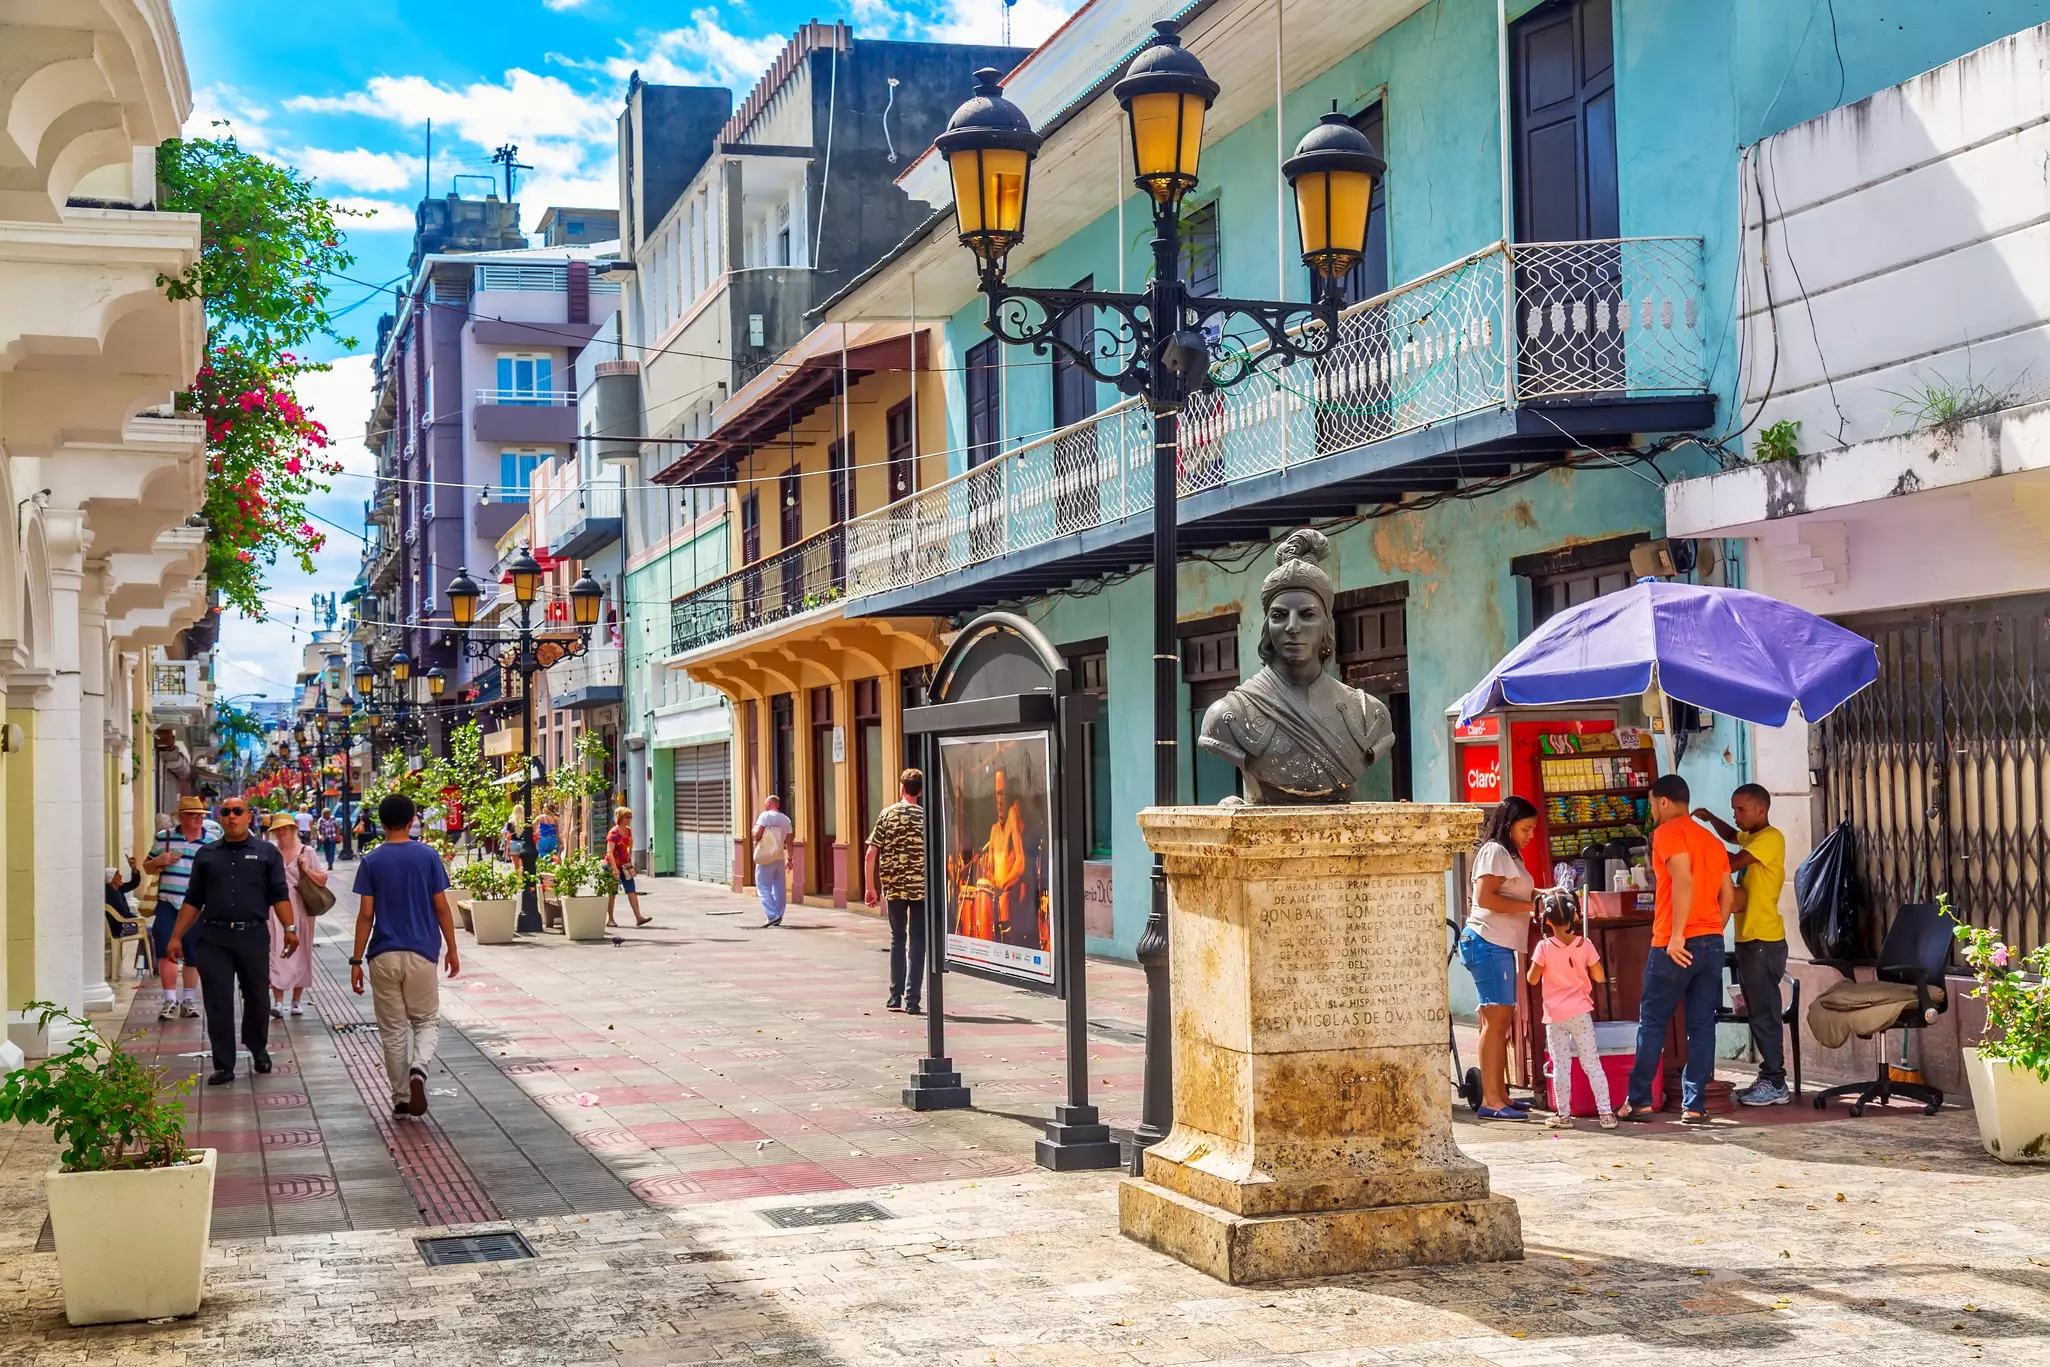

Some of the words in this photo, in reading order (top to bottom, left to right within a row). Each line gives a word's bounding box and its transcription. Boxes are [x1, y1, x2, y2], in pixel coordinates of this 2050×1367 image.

[1467, 725, 1483, 736] Claro
[1467, 769, 1497, 789] Claro
[1327, 881, 1344, 890] DEL
[1347, 880, 1382, 890] PRIMER
[1275, 895, 1286, 905] DE
[1261, 908, 1291, 922] DON
[1330, 923, 1341, 932] LA
[1361, 935, 1373, 944] DE
[1335, 947, 1383, 957] DOMINGO
[1348, 960, 1365, 970] DEL
[1341, 973, 1357, 983] SER
[1363, 1011, 1380, 1025] DE
[1384, 1007, 1445, 1024] OVANDO
